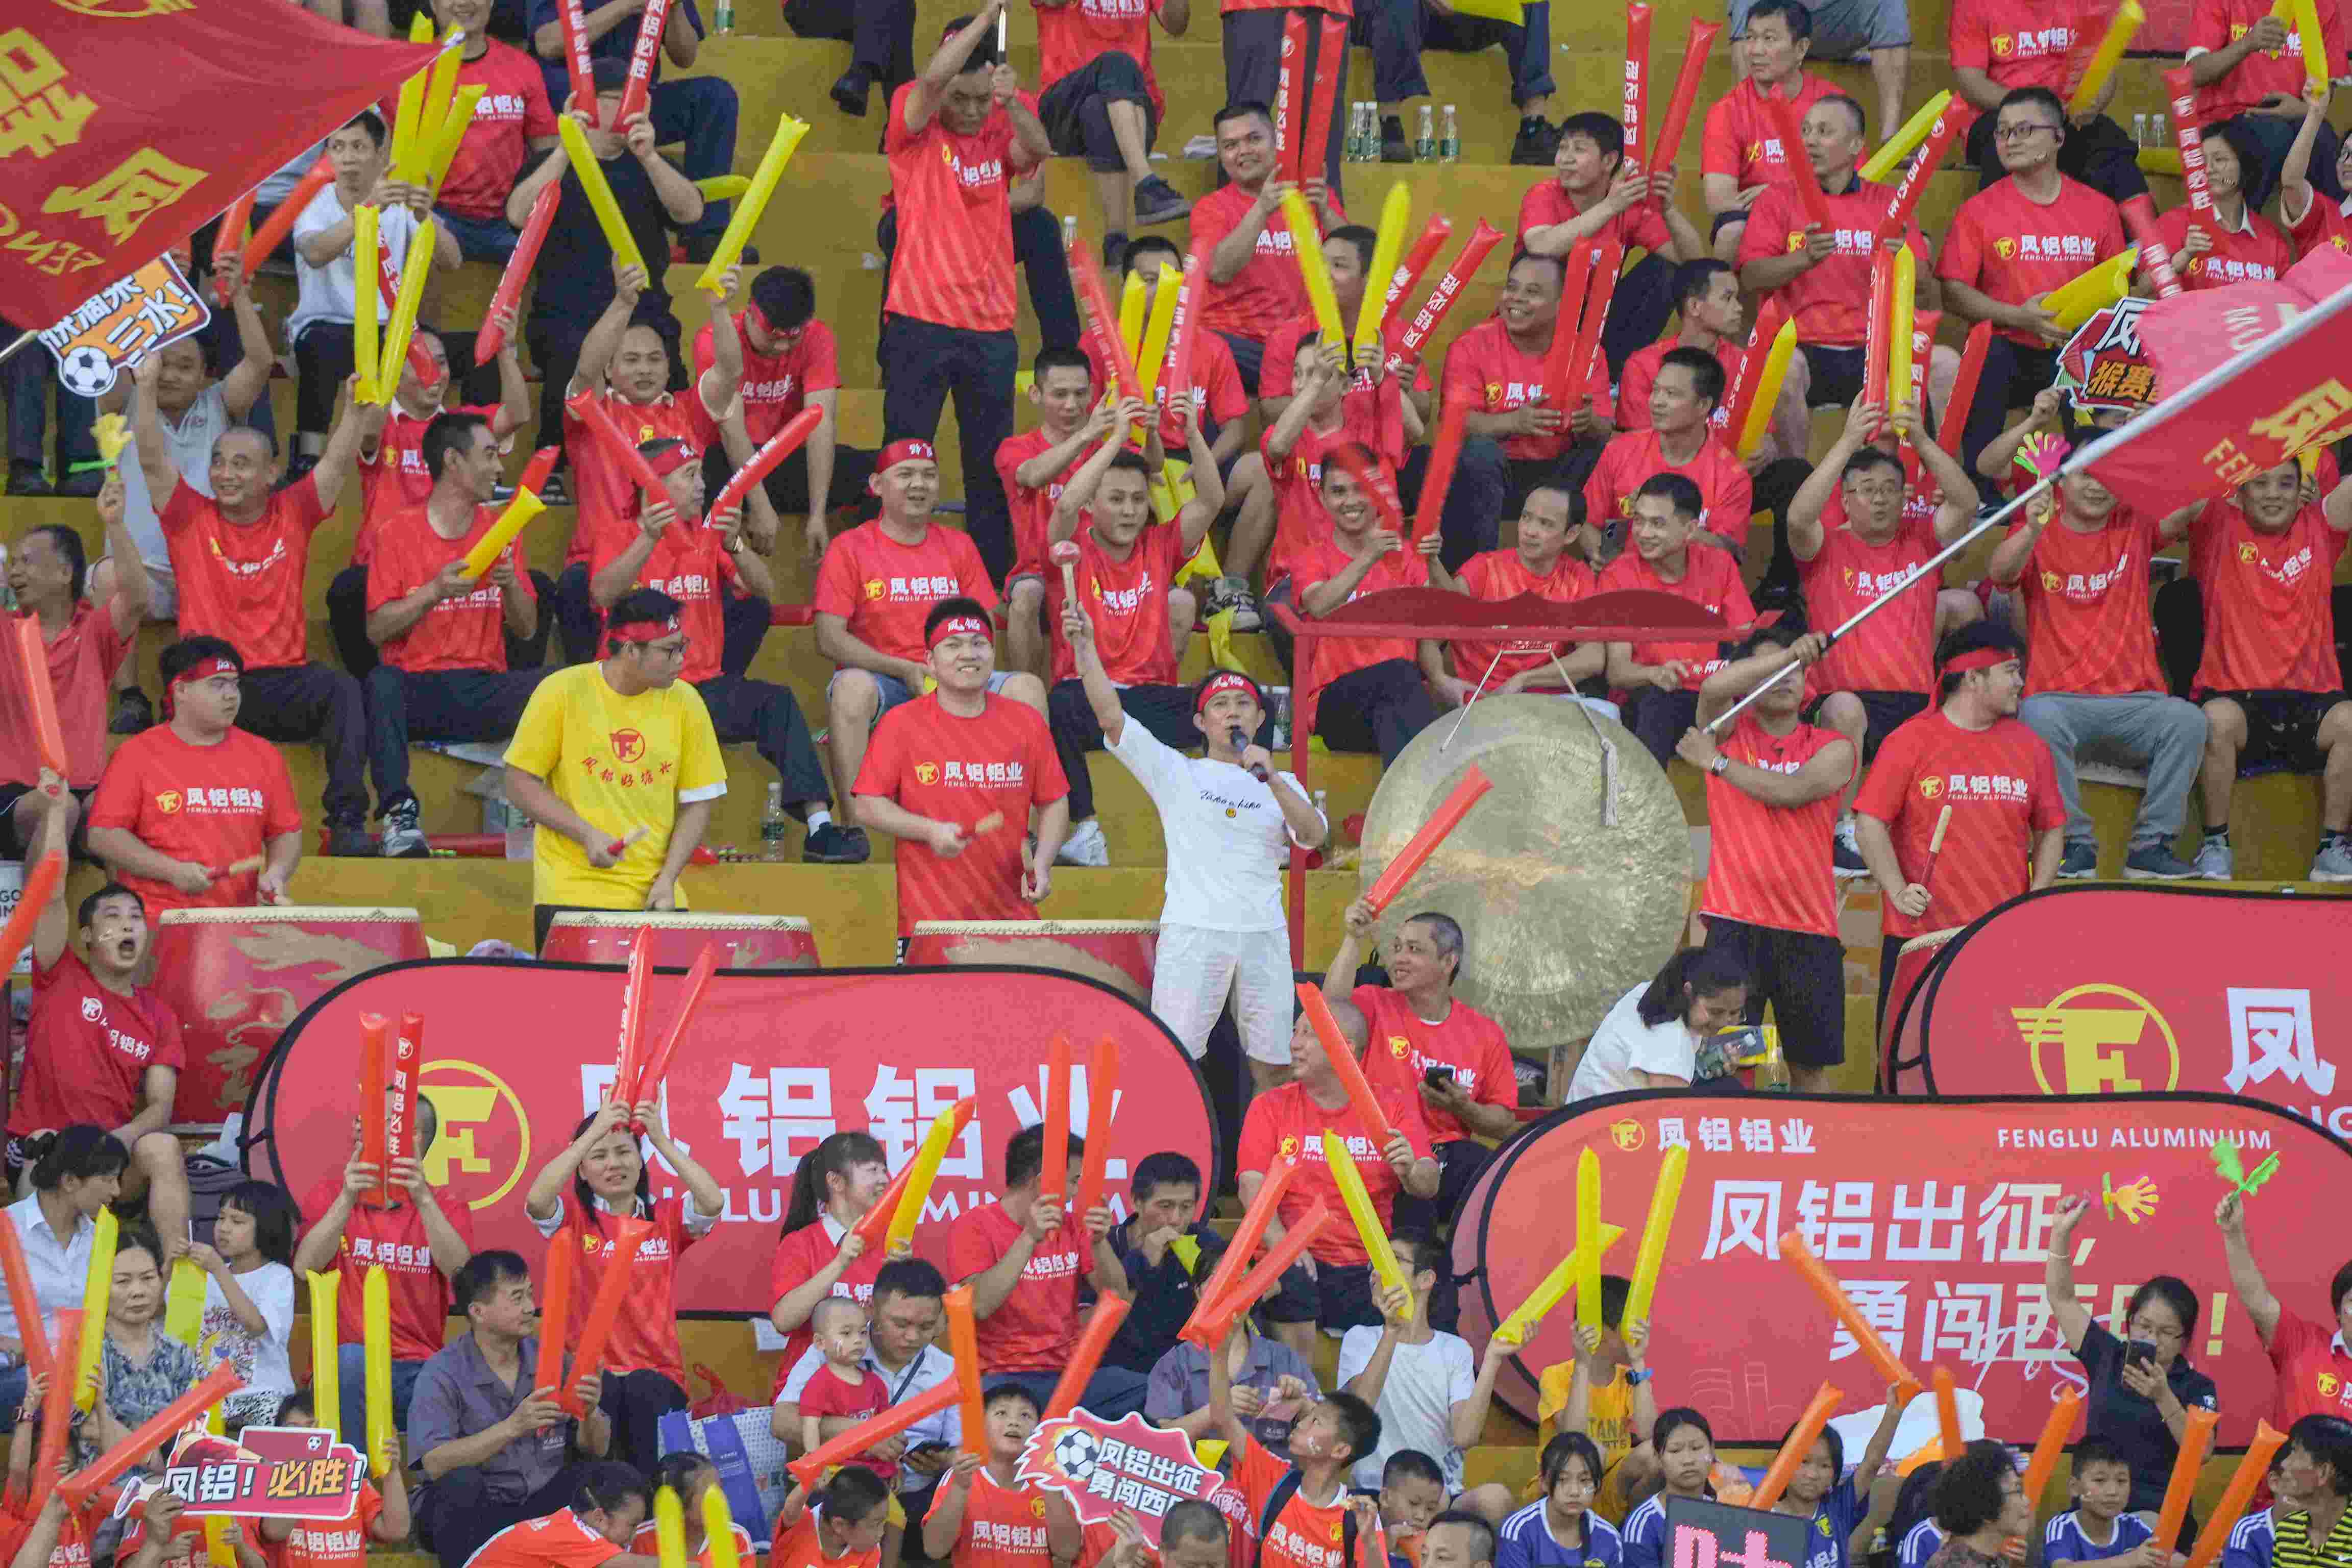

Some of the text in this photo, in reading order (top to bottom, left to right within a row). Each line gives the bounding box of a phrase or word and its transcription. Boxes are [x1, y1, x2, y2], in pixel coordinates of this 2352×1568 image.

[2020, 235, 2096, 255] 凤铝铝业
[2207, 258, 2276, 280] 凤铝铝业
[2067, 553, 2127, 592] 凤铝
[944, 761, 1023, 782] 凤铝铝业
[1949, 775, 2028, 796] 凤铝铝业
[187, 788, 263, 808] 凤铝铝业
[2223, 987, 2337, 1096] 凤
[1304, 1135, 1378, 1155] 凤铝
[1658, 1117, 1816, 1154] 凤铝铝业
[1998, 1128, 2271, 1149] FENGLU ALUMINIUM
[353, 1237, 431, 1266] 凤铝铝业
[832, 1282, 873, 1300] 凤铝
[268, 1458, 365, 1498] 必胜!
[1095, 1437, 1205, 1496] 凤铝出征
[1086, 1466, 1185, 1517] 勇闯西
[288, 1529, 361, 1552] 凤铝铝业
[972, 1521, 1048, 1547] 凤铝铝业
[1271, 1522, 1344, 1568] 凤铝铝业
